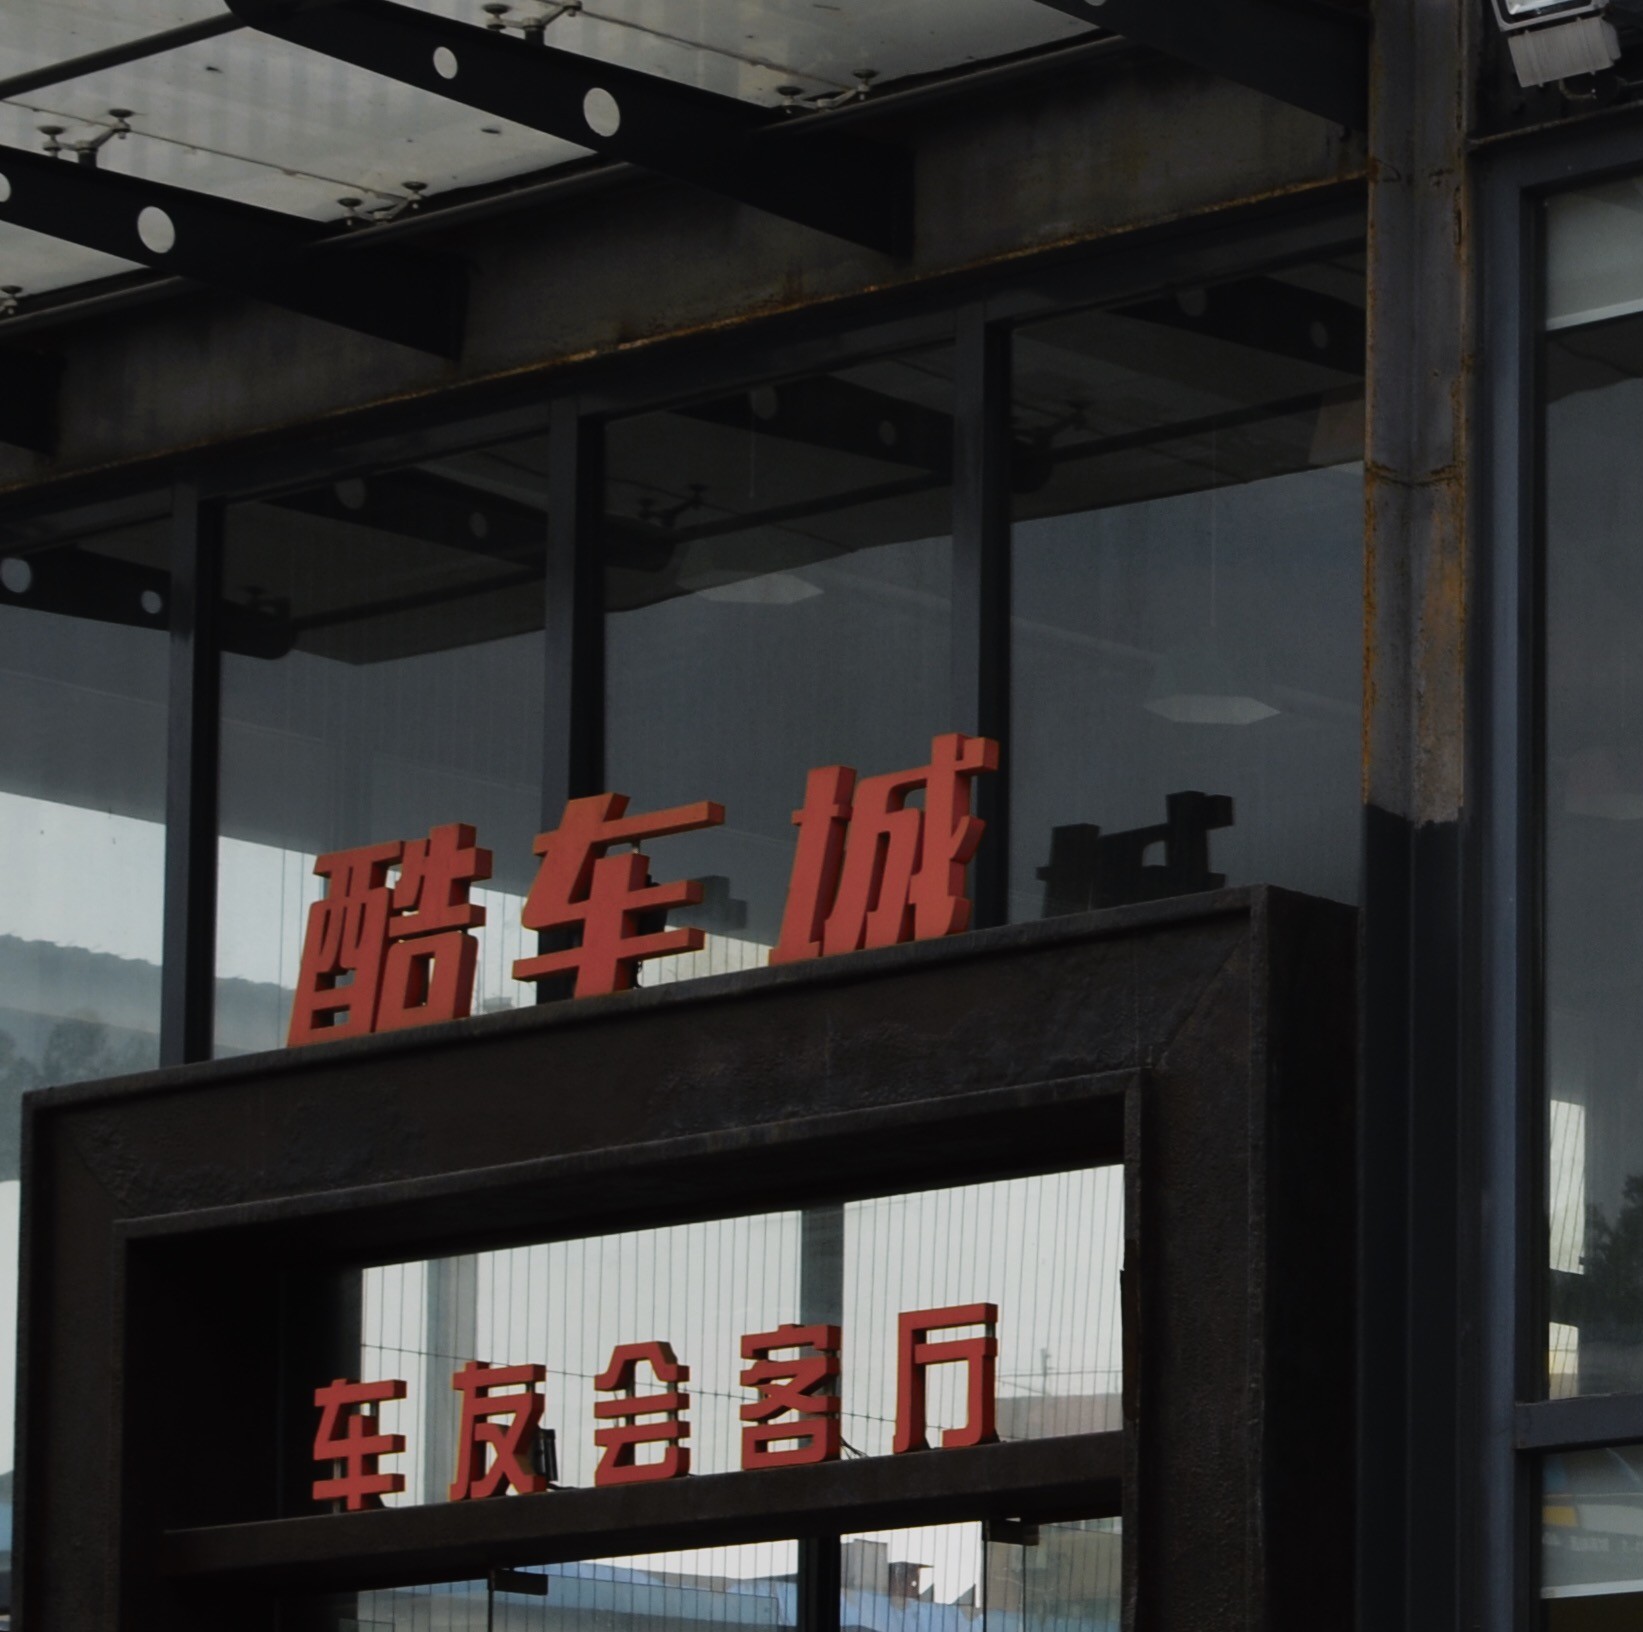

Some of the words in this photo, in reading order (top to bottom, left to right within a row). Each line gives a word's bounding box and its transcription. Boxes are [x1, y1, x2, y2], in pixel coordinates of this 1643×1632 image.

[287, 733, 1000, 1047] 酷车城
[312, 1302, 1000, 1511] 车友会客厅
